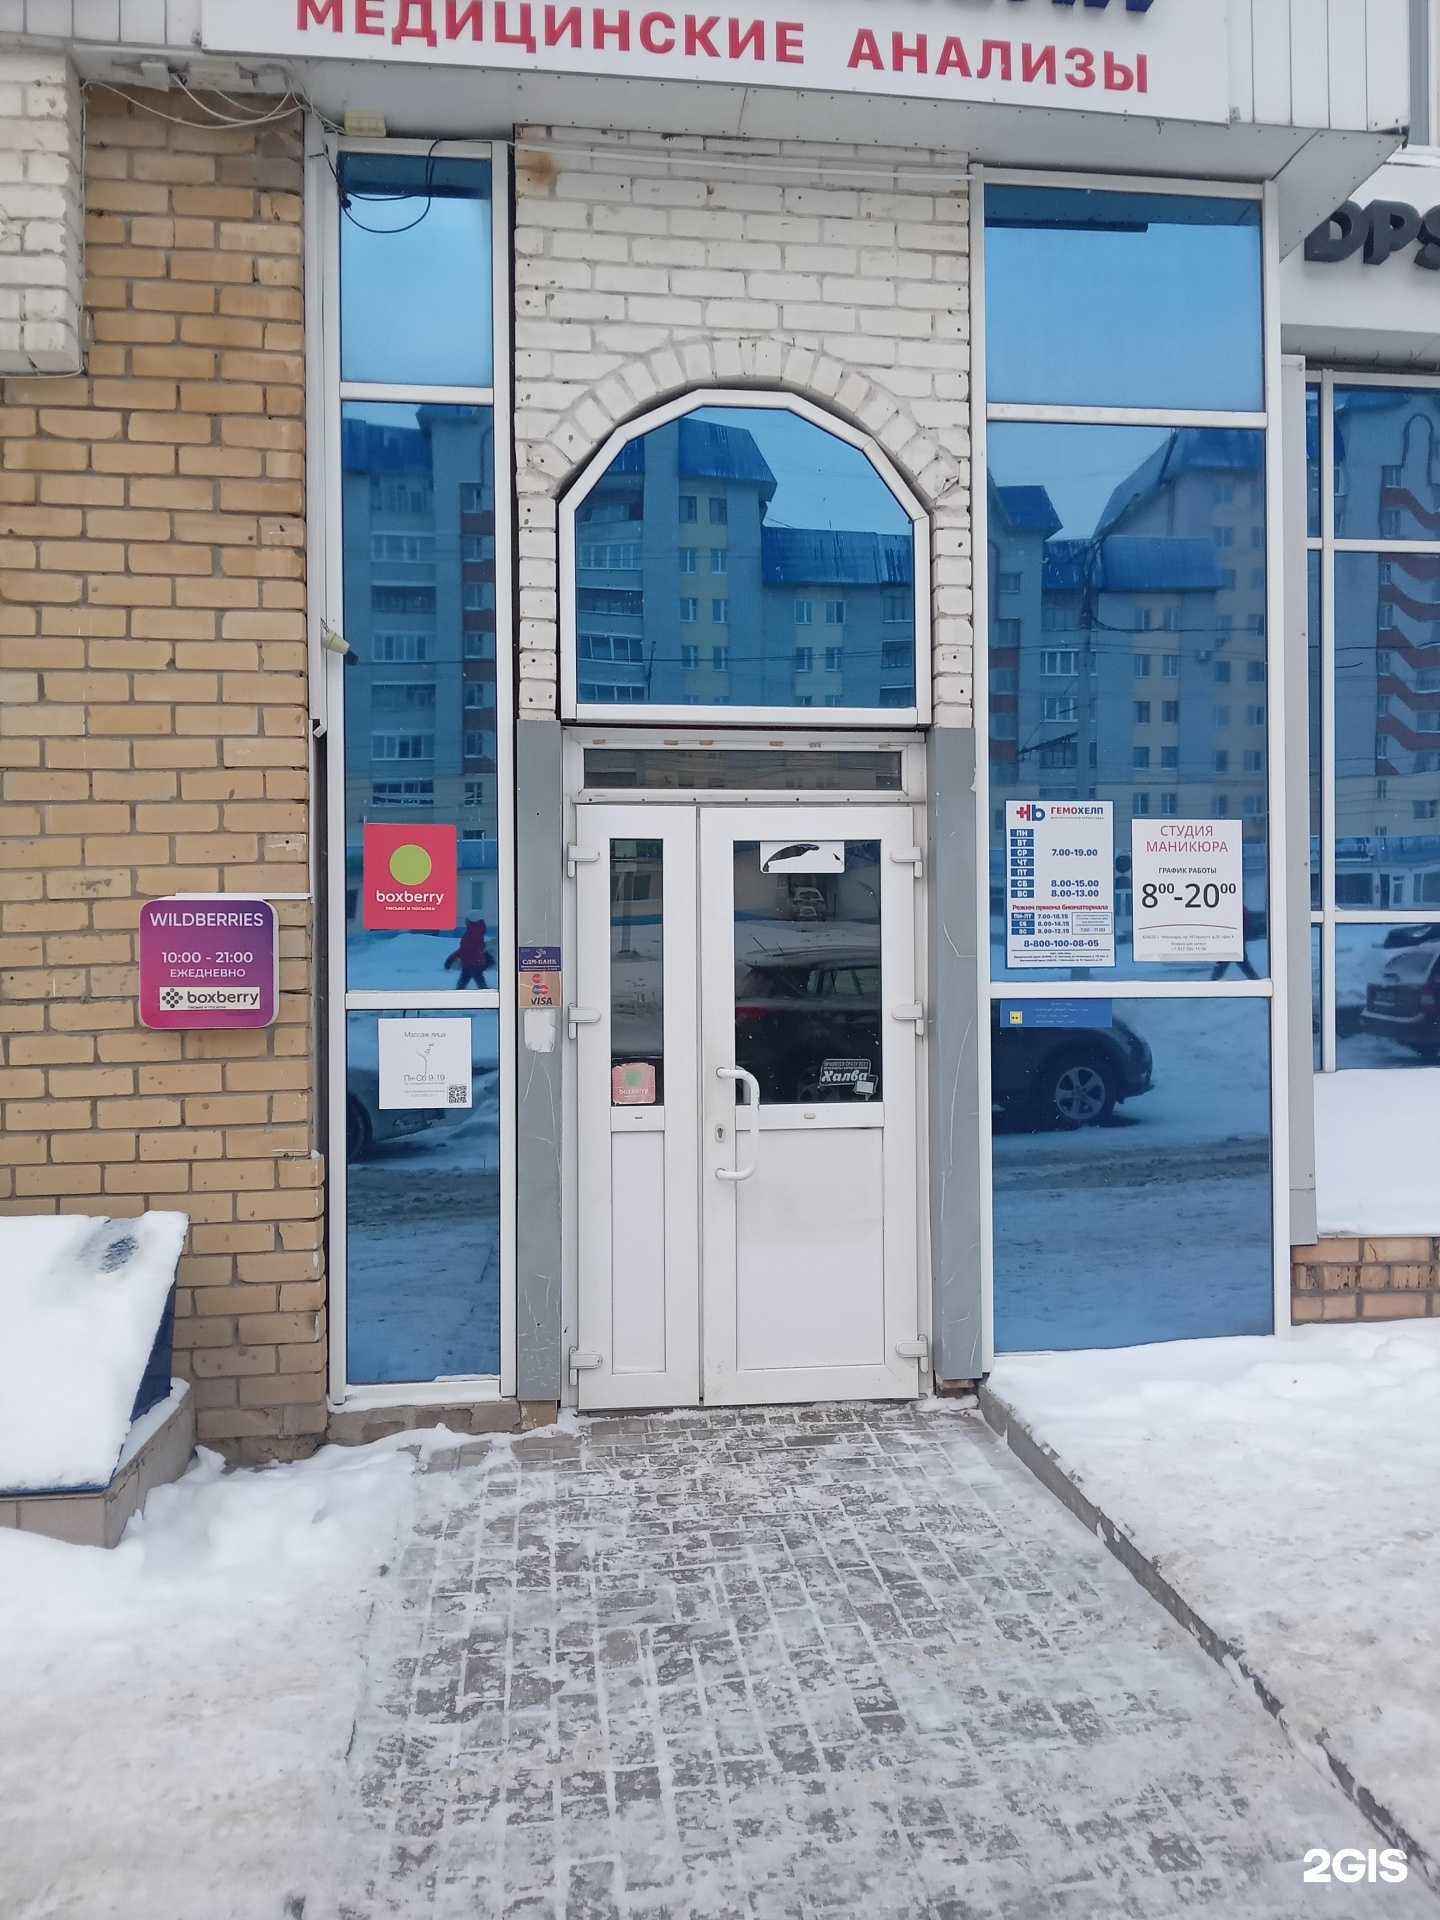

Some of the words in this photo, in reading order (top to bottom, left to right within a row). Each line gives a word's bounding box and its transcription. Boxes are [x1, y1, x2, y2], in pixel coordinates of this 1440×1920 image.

[297, 0, 804, 64] МЕДИЦИНСКИЕ
[847, 28, 1148, 93] АНАЛИЗЫ
[1050, 807, 1104, 815] ГЕМОХЕЛП
[1160, 825, 1213, 838] СТУДИЯ
[1146, 841, 1228, 852] МАНИКЮРА
[1051, 849, 1098, 857] 7.00-19.00
[376, 889, 444, 905] boxberry
[150, 912, 264, 927] WILDBERRIES
[1024, 939, 1099, 947] 8-800-100-08-05
[162, 952, 201, 963] 10:00
[215, 952, 253, 963] 21:00
[170, 968, 246, 979] ЕЖЕДНЕВНО
[187, 991, 259, 1005] boxberry
[531, 997, 553, 1005] VISA
[821, 1070, 868, 1082] Халва
